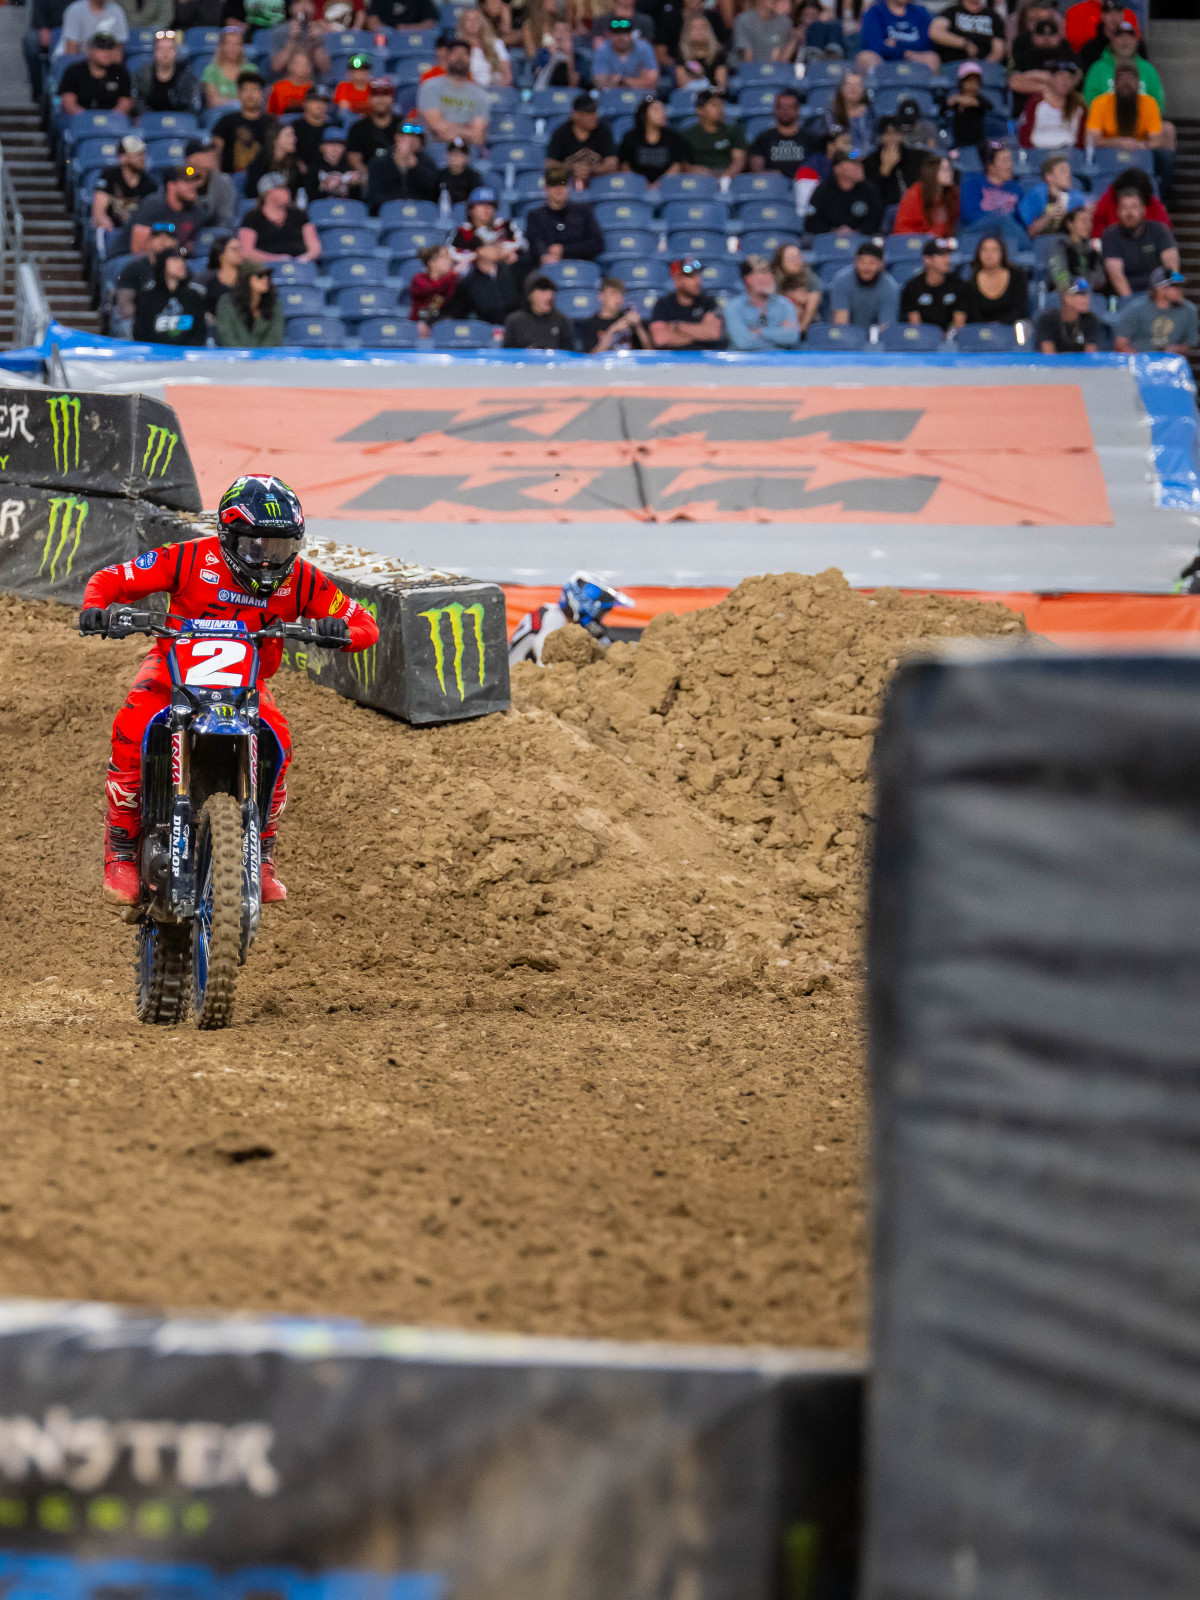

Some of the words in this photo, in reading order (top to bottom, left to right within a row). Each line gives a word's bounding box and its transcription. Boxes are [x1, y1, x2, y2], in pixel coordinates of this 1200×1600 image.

[230, 592, 267, 608] YAMAHA
[184, 640, 247, 687] 2
[172, 814, 182, 878] DUNLOP
[249, 819, 260, 884] DUNLOP
